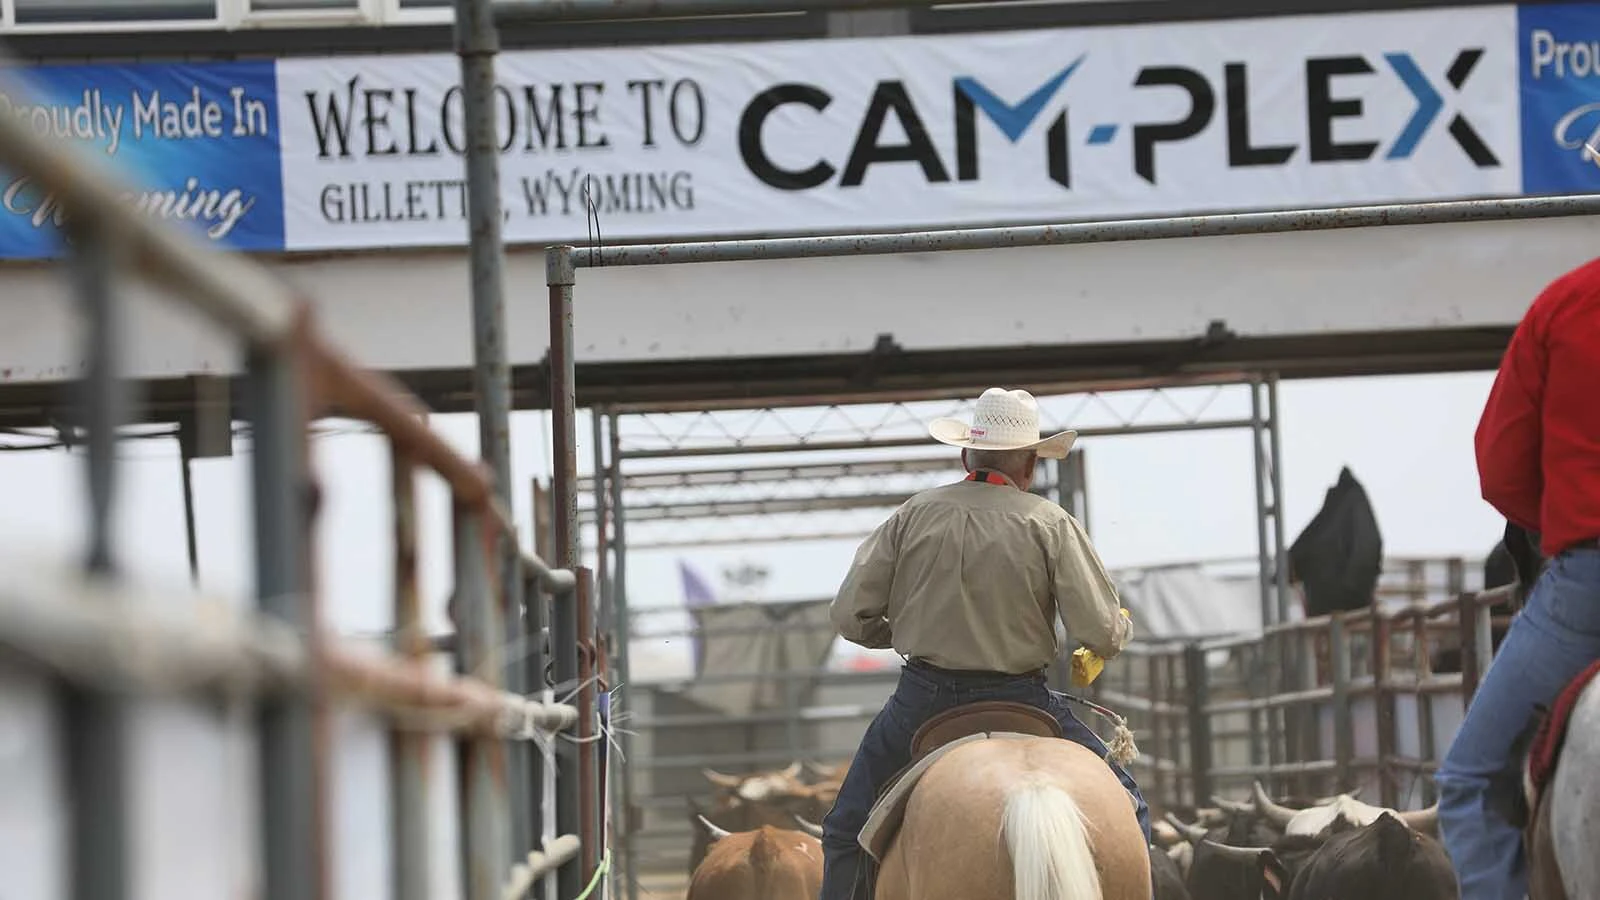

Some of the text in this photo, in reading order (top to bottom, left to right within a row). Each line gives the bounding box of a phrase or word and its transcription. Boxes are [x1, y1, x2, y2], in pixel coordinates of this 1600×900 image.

[132, 86, 222, 138] Made
[230, 87, 268, 136] In
[305, 75, 706, 158] WELCOME TO
[738, 47, 1501, 192] CAM-PLEX
[320, 167, 695, 224] GILLETT, WYOMING
